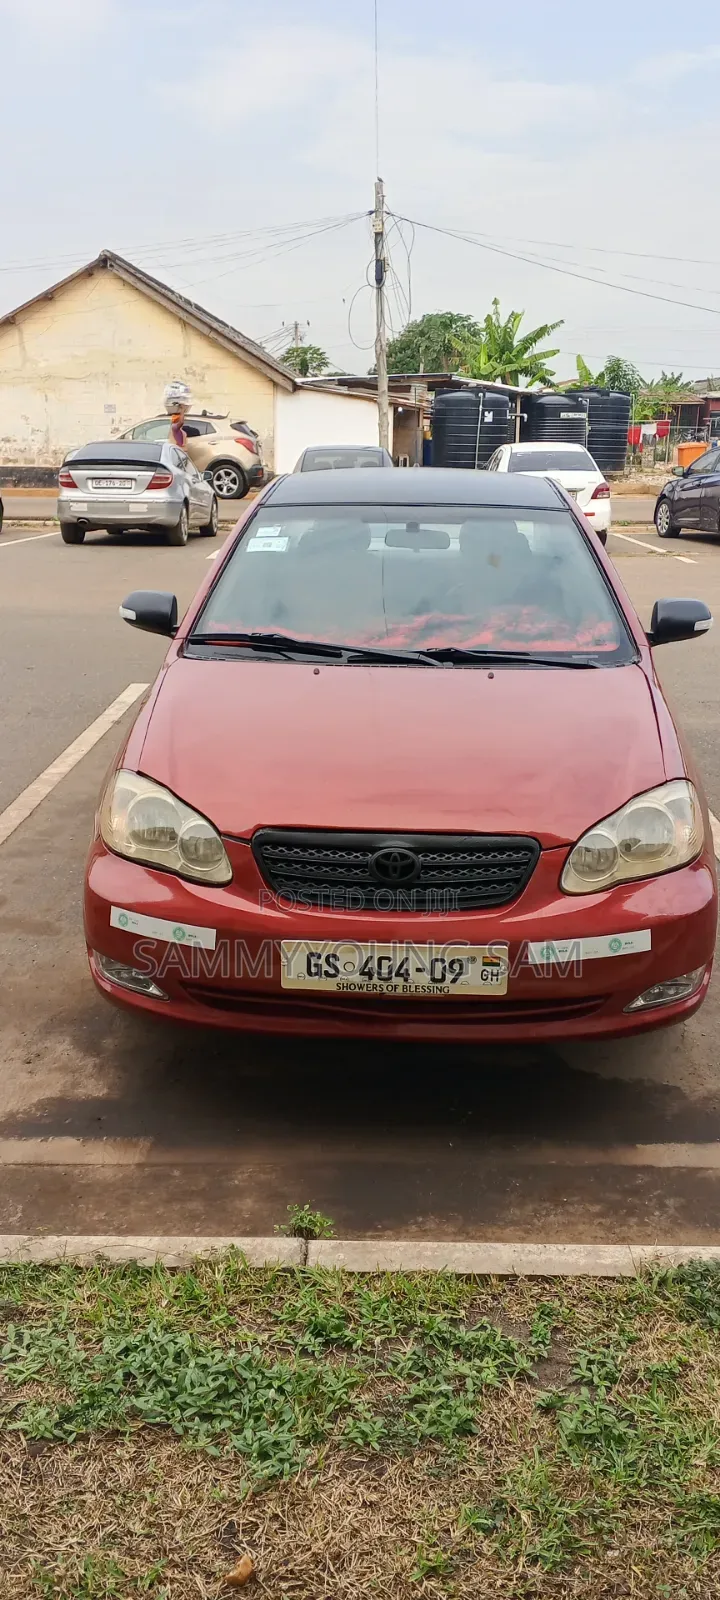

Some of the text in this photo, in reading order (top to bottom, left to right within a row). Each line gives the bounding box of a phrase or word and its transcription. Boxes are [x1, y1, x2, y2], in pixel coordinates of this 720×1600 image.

[306, 951, 464, 984] GS 404-09
[480, 968, 500, 982] GH
[336, 982, 450, 994] SHOWERS OF BLESSING
